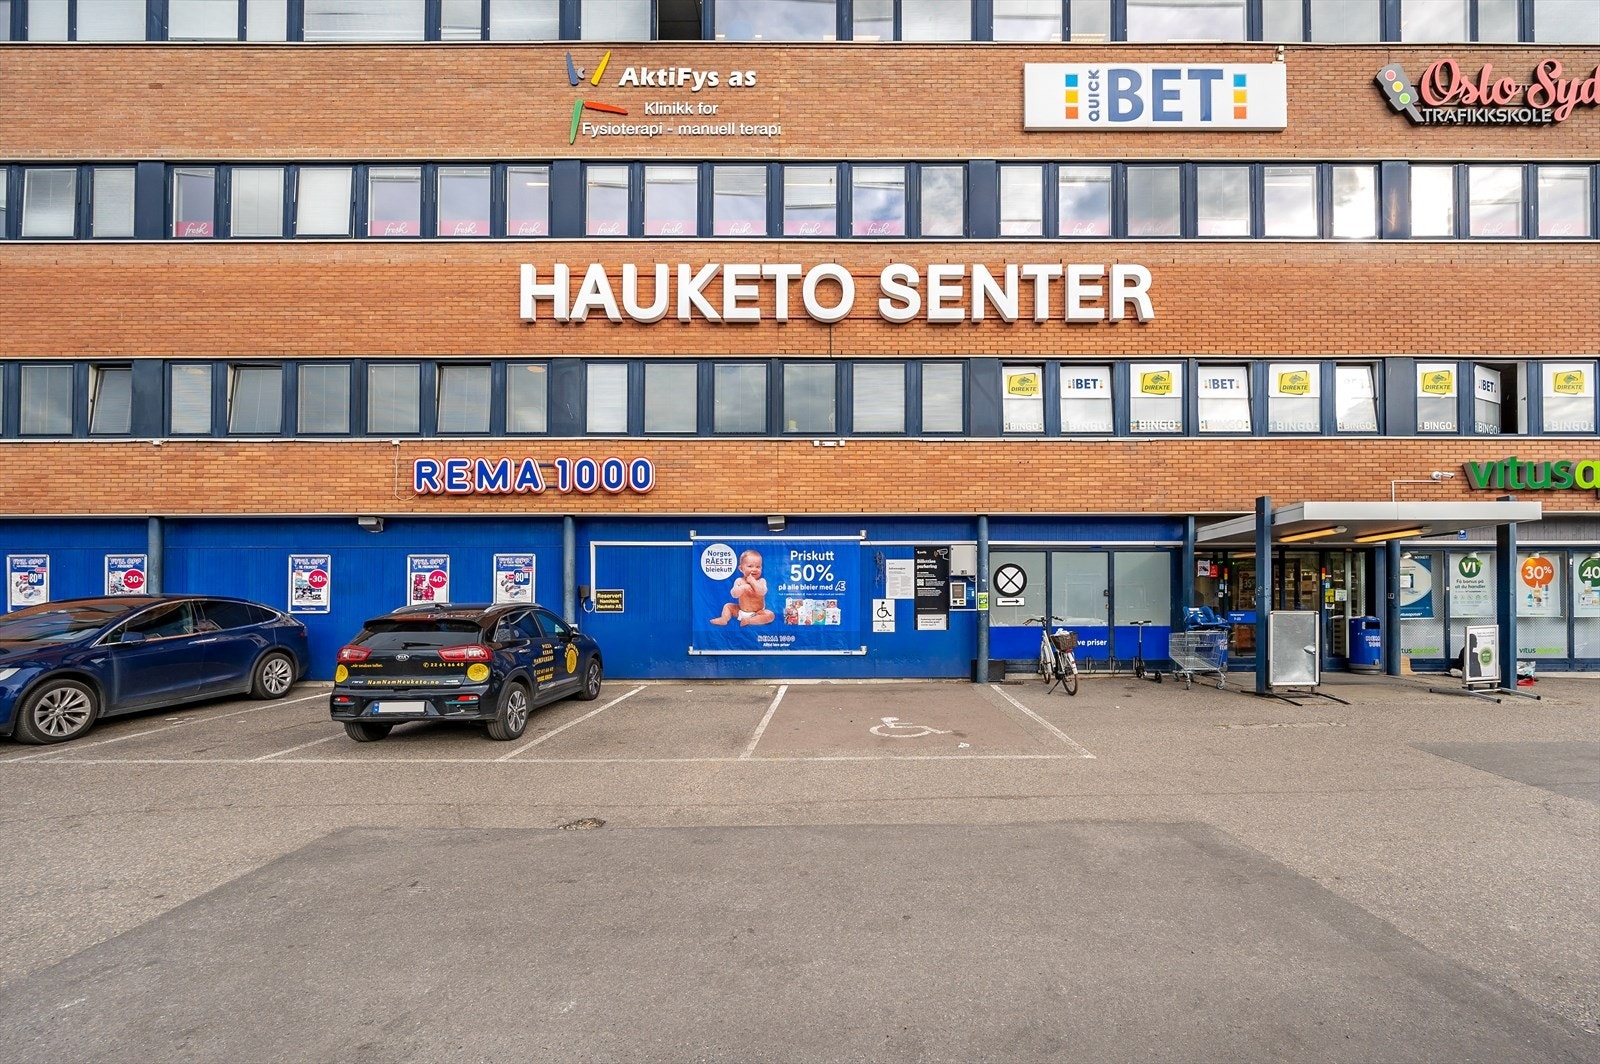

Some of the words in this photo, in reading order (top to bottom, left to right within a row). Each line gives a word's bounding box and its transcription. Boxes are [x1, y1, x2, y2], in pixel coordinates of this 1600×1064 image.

[618, 67, 719, 92] AktiFys
[728, 70, 757, 87] as
[1088, 69, 1100, 122] QUICK
[1107, 69, 1224, 122] BET
[1420, 58, 1522, 106] Oslo
[1527, 58, 1600, 121] Syd
[644, 102, 694, 115] Klinikk
[697, 102, 719, 115] for
[1422, 108, 1552, 122] TRAFIKKSKOLE
[582, 122, 663, 137] Fysioterapi
[678, 122, 735, 136] manuell
[739, 122, 782, 137] terapi
[520, 262, 855, 323] HAUKETO
[878, 263, 1155, 323] SENTER
[1076, 378, 1099, 390] BET
[1212, 379, 1235, 390] BET
[1482, 379, 1495, 392] BET
[1138, 420, 1176, 430] BINGO
[1424, 421, 1452, 430] BINGO
[1478, 422, 1498, 434] BINGO
[413, 457, 546, 494] REMA
[554, 457, 655, 494] 1000
[705, 556, 733, 565] RÅESTE
[707, 550, 731, 558] Norges
[790, 550, 834, 561] Priskutt
[790, 564, 834, 582] 50%
[1461, 561, 1477, 573] VI
[1524, 565, 1552, 580] 30%
[778, 583, 787, 591] på
[787, 583, 799, 591] alle
[800, 583, 818, 591] bleier
[819, 583, 833, 591] med
[1087, 639, 1108, 647] priser
